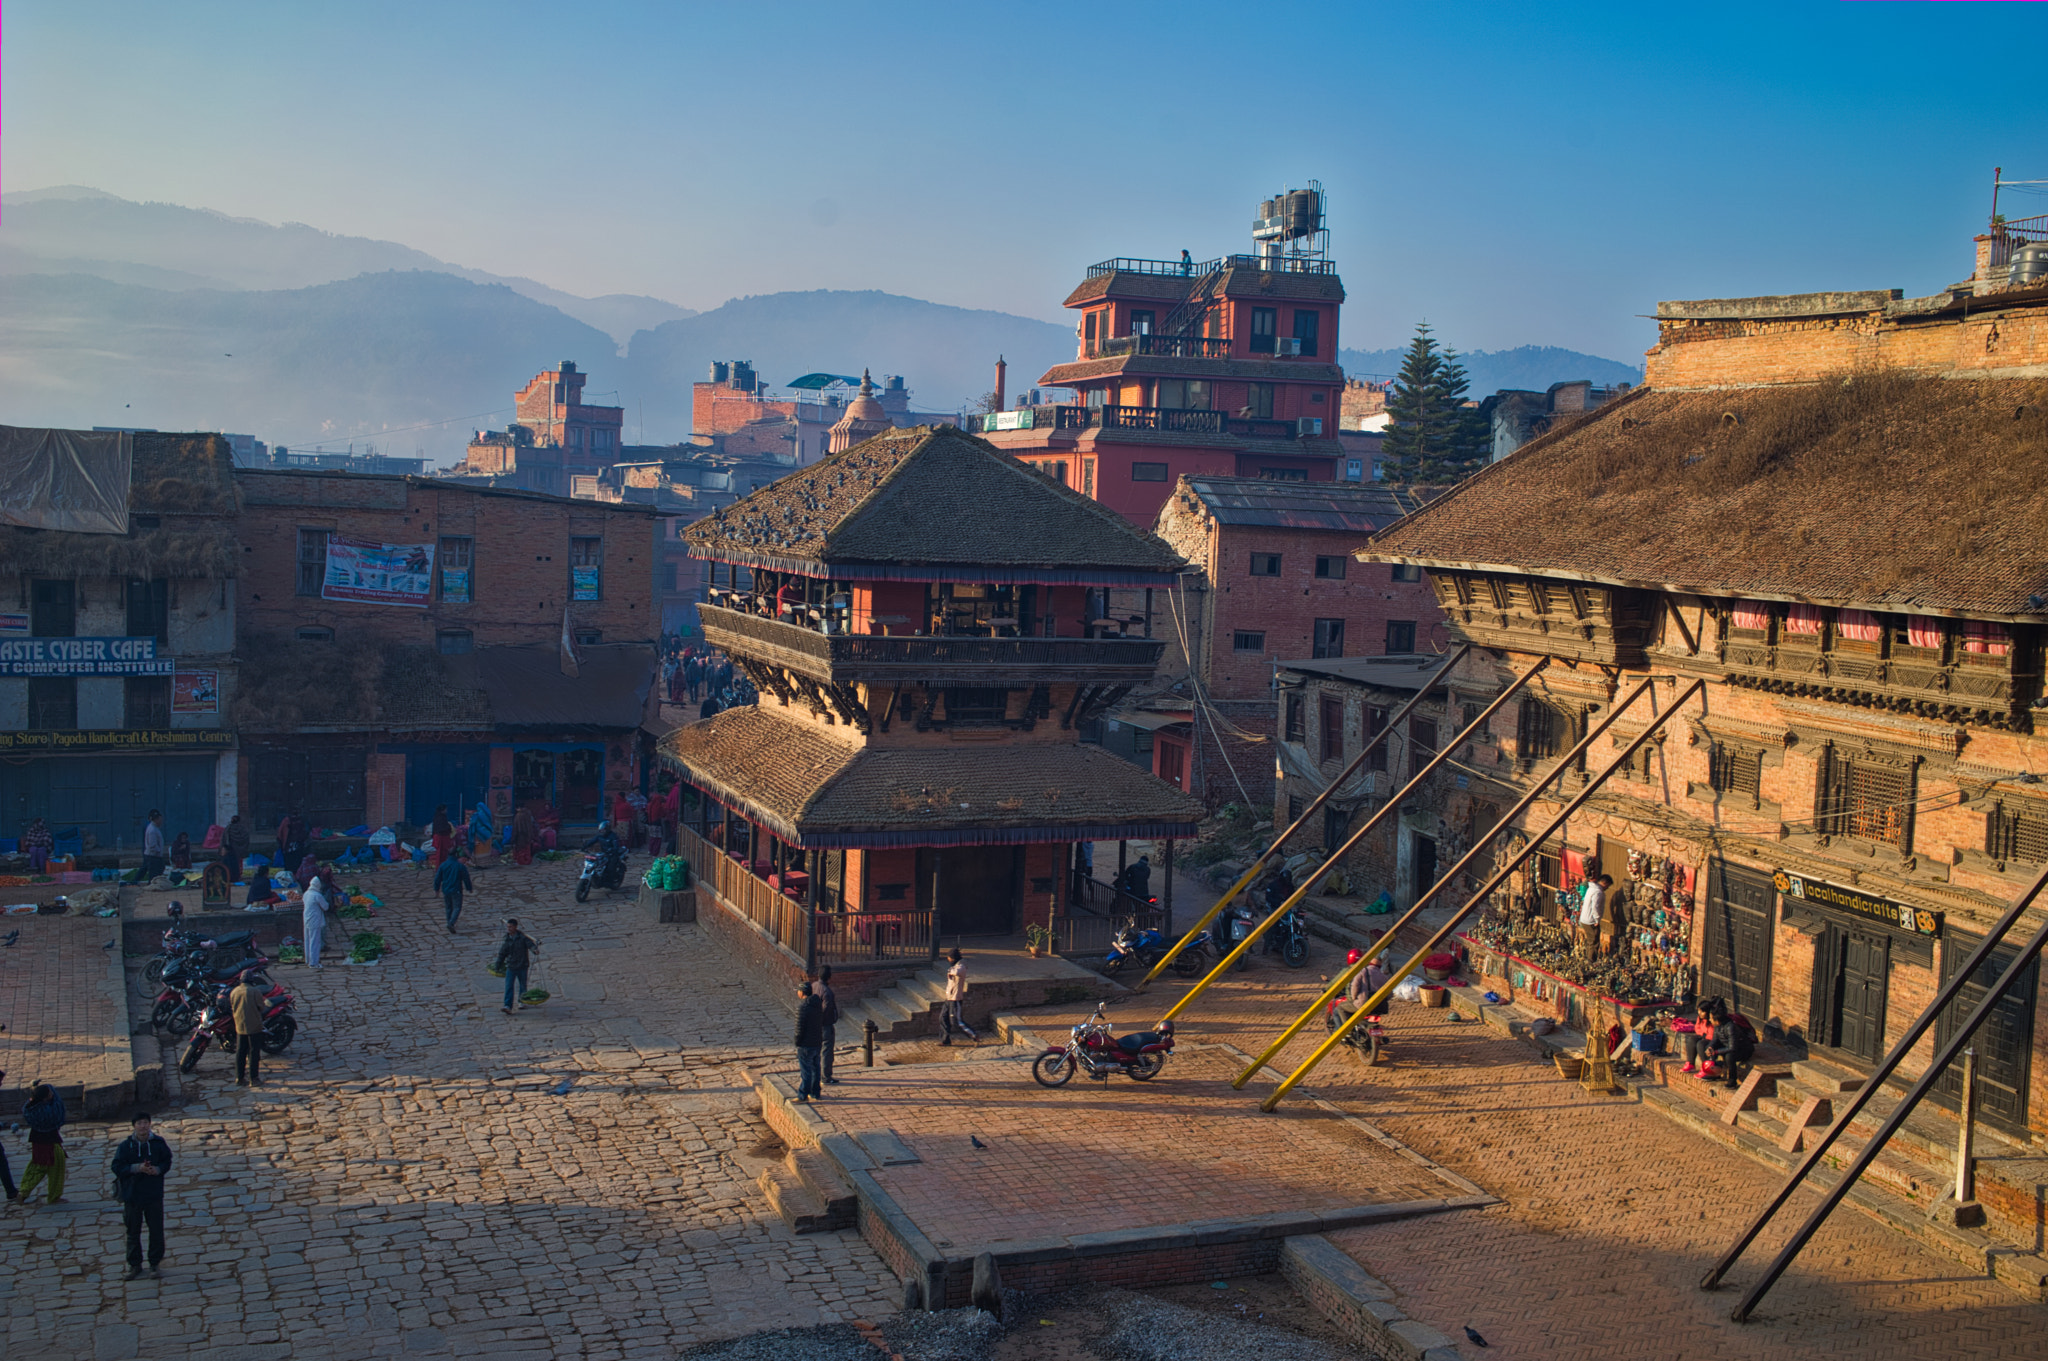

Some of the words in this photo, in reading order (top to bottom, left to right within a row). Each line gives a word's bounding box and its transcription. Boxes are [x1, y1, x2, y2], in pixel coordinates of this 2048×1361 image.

[0, 640, 44, 660] ASTE
[49, 640, 106, 660] CYBER
[111, 640, 153, 660] CAFE
[13, 662, 95, 673] COMPUTER
[98, 661, 173, 672] INSTITUTE
[16, 732, 48, 744] Store
[53, 732, 87, 747] Pagoda
[88, 731, 141, 744] Handicraft
[141, 731, 149, 743] &
[151, 730, 197, 743] Pashmina
[199, 730, 232, 742] Centre
[1804, 881, 1898, 920] localhandicrafts
